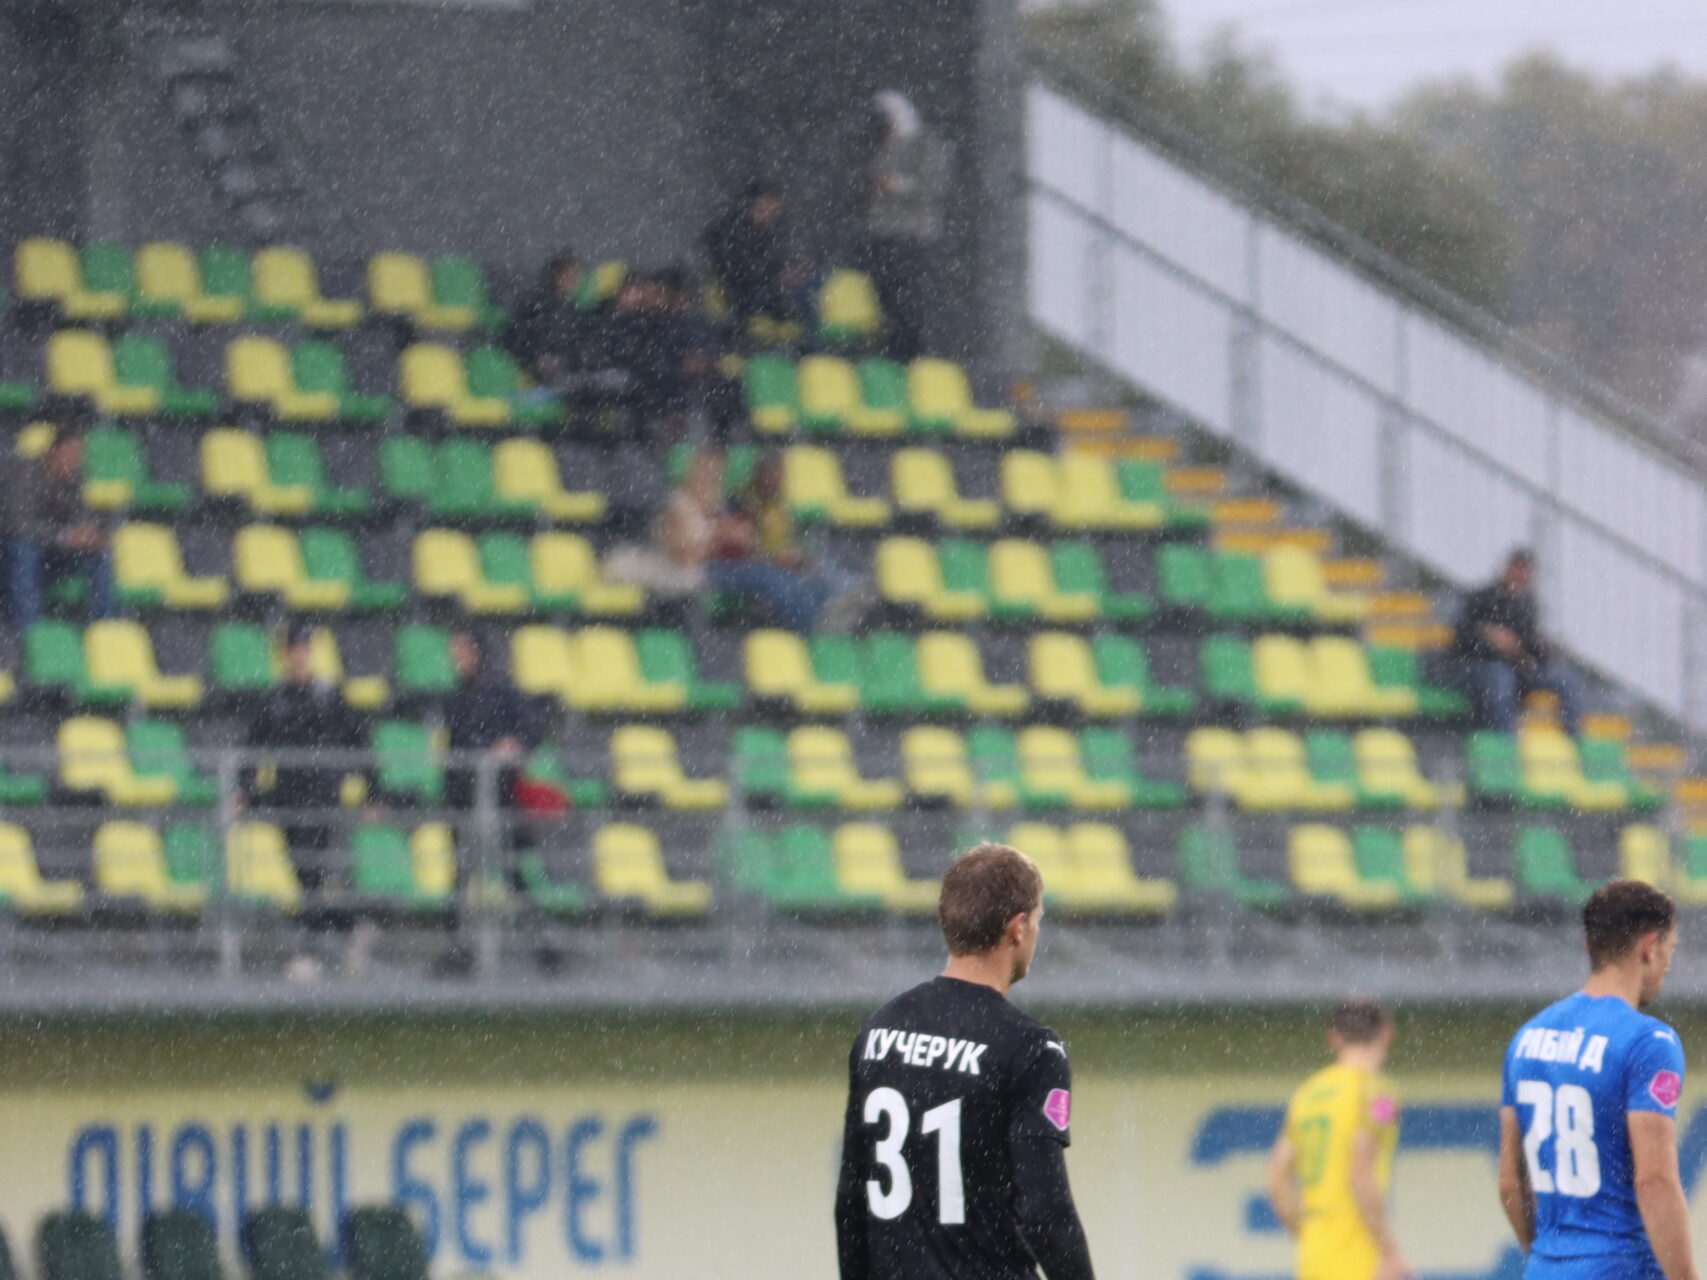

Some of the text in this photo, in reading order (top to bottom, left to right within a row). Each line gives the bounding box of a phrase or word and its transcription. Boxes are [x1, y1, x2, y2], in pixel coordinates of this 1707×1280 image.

[863, 1028, 988, 1075] КУЧЕРУК
[390, 1113, 658, 1266] БЕРЕГ
[863, 1086, 966, 1225] 31
[1516, 1079, 1601, 1198] 28
